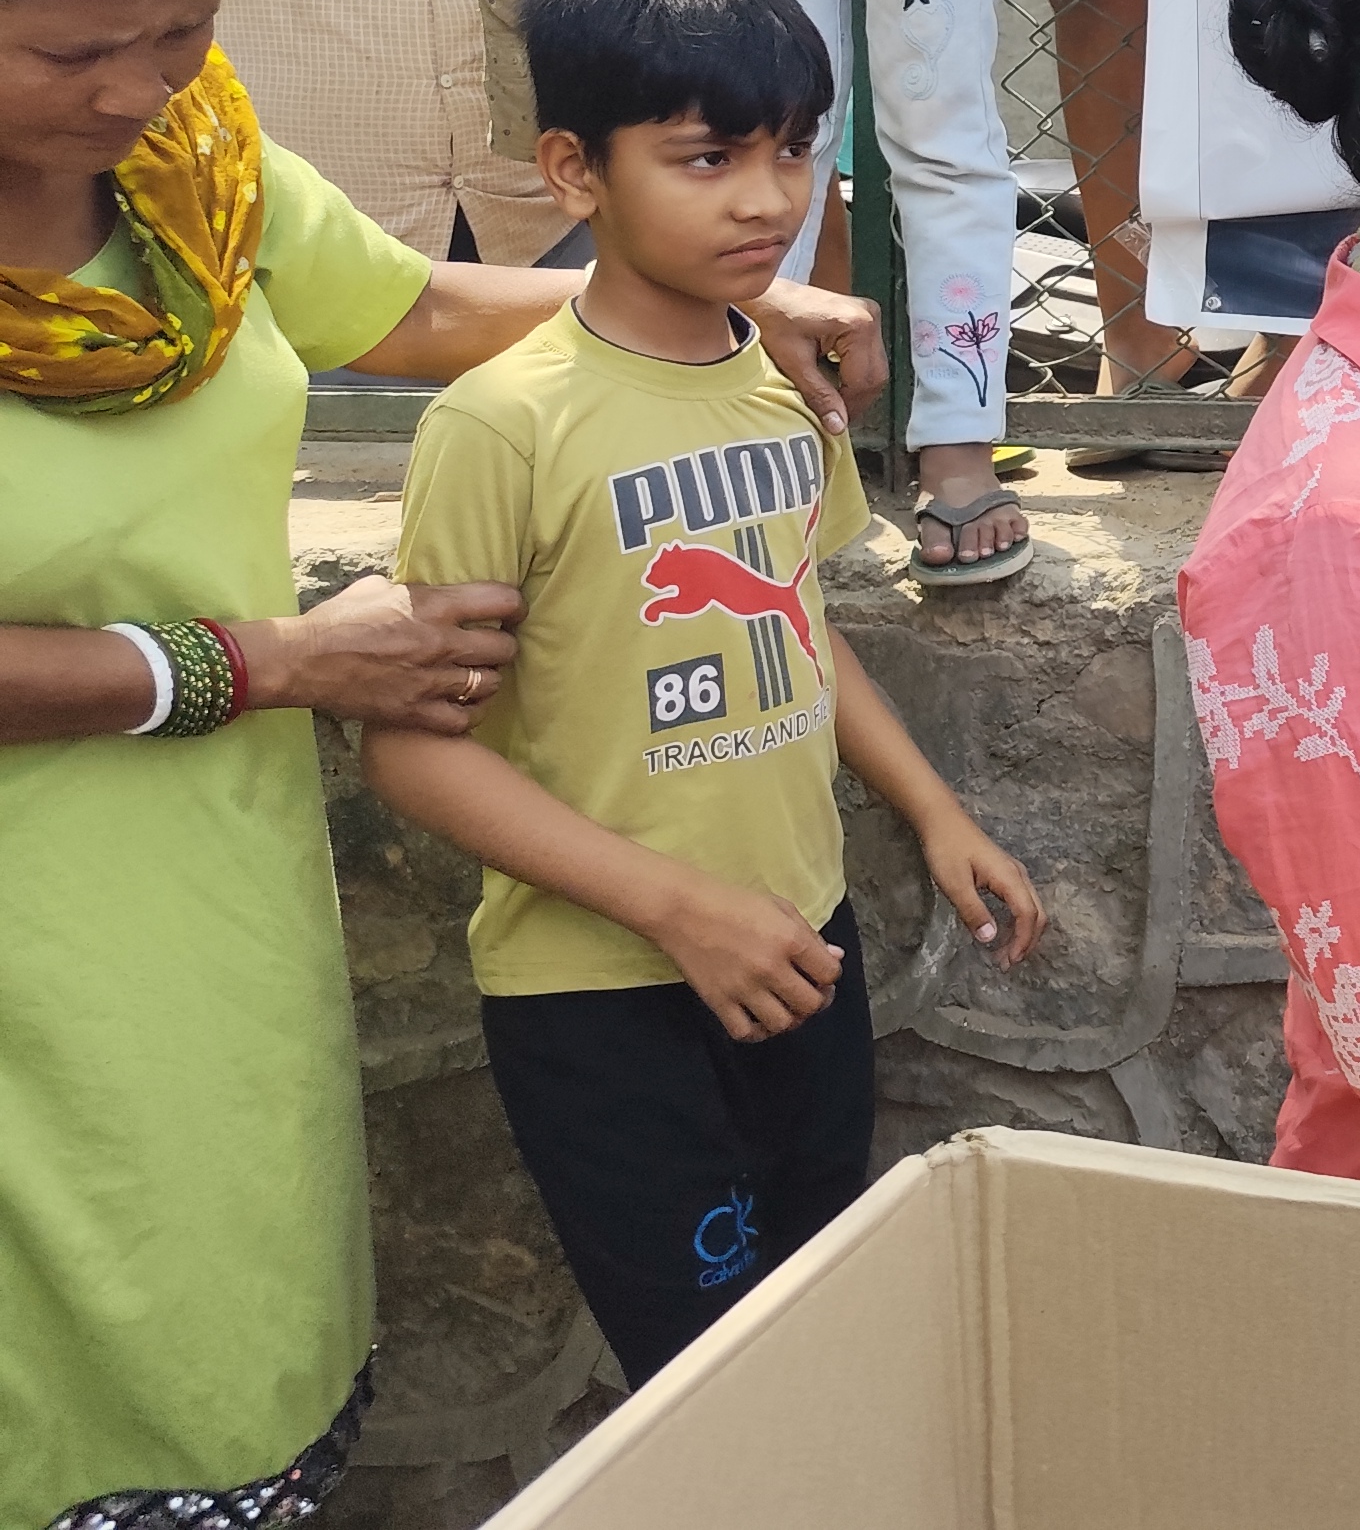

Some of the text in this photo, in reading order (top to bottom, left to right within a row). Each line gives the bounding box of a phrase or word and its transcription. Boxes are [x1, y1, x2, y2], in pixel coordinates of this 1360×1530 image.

[608, 431, 824, 555] PUMA
[654, 663, 722, 723] 86
[643, 727, 754, 776] TRACK
[759, 710, 809, 753] AND
